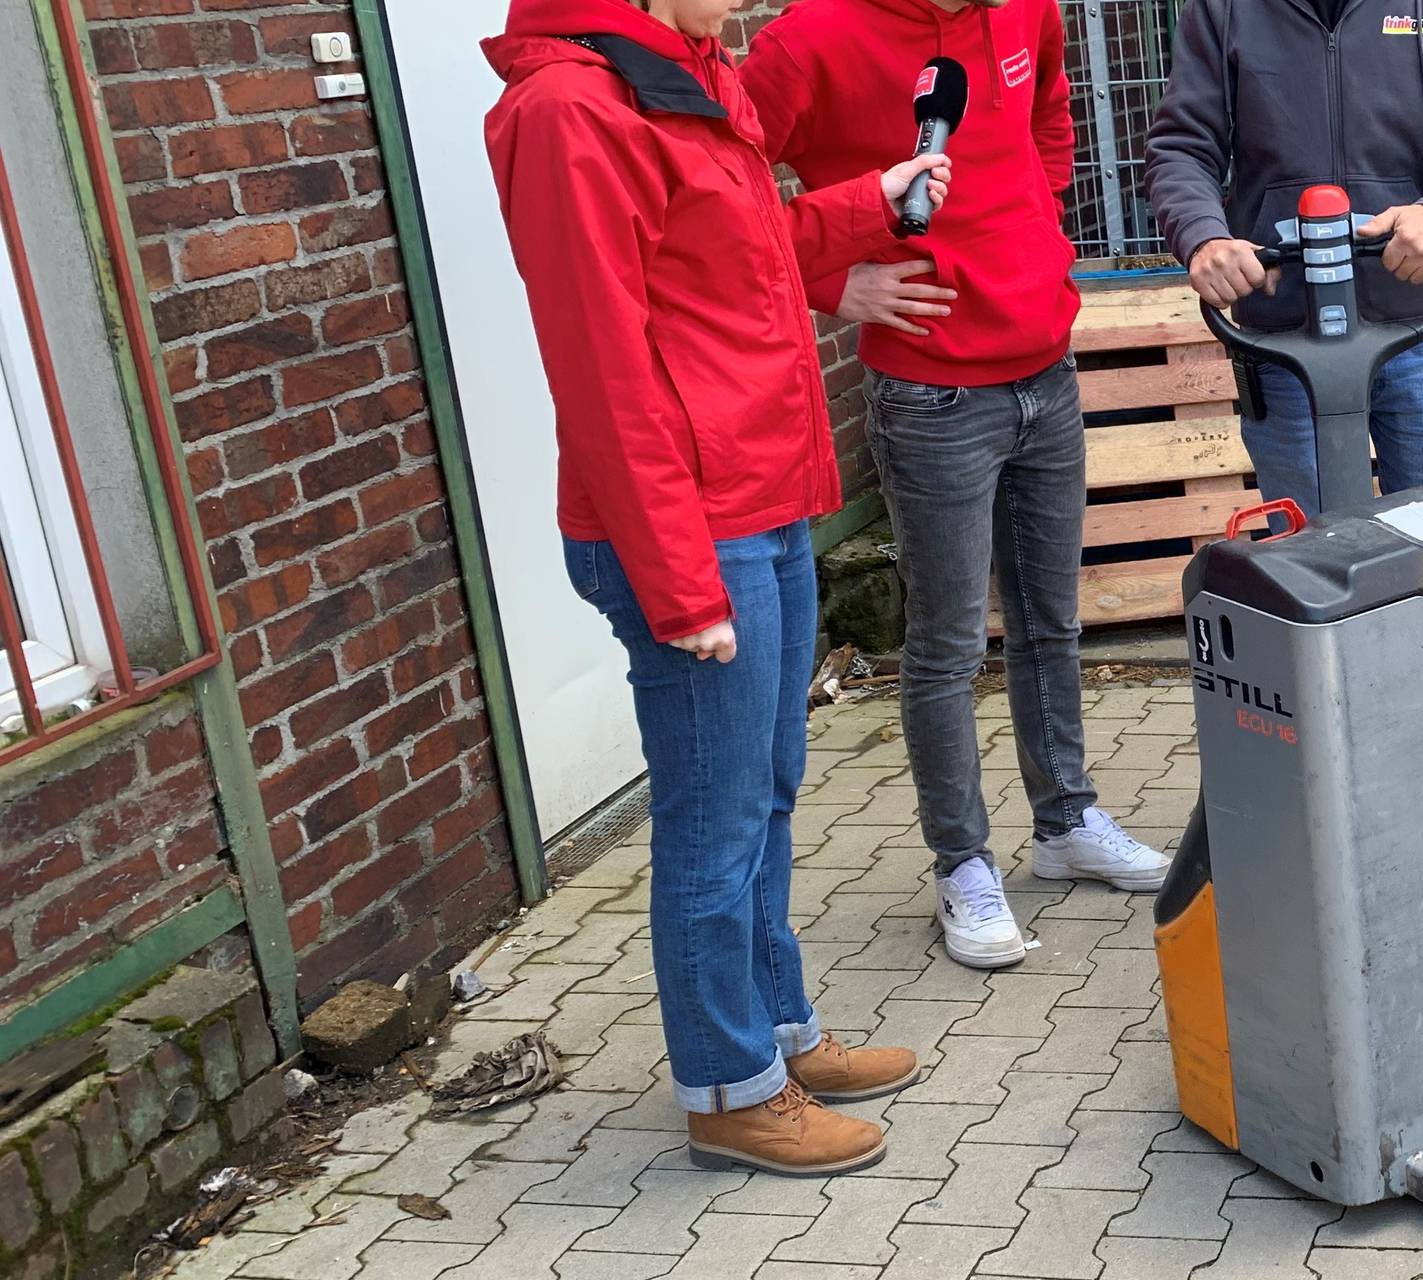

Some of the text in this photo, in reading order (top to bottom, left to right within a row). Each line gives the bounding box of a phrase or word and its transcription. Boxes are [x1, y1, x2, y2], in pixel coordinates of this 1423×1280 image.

[1192, 666, 1293, 719] STILL
[1236, 708, 1298, 745] ECU 16
